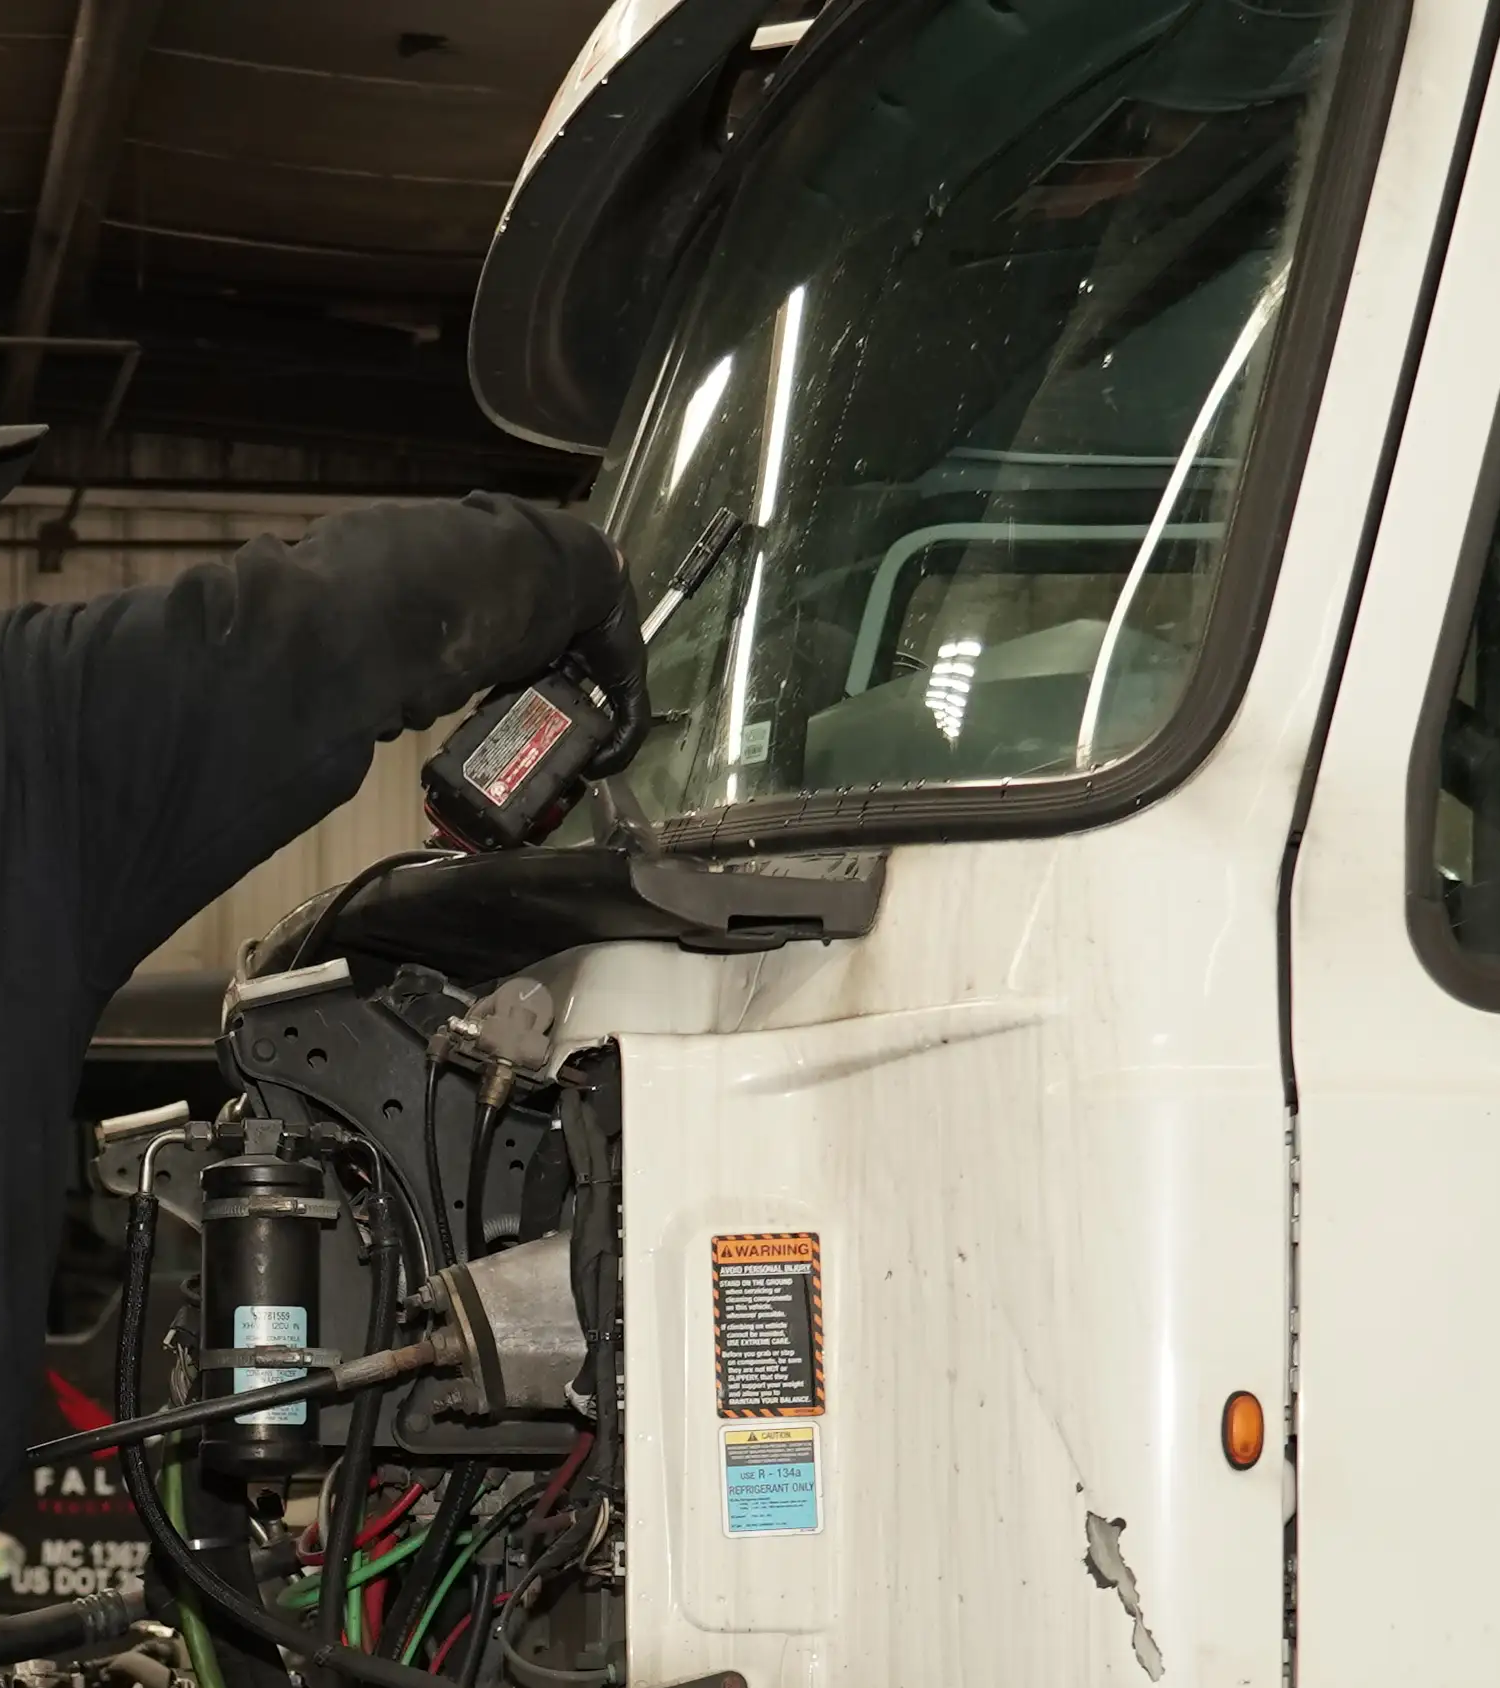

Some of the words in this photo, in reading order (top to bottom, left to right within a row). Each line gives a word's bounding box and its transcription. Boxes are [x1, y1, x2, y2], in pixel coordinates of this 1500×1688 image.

[736, 1244, 809, 1257] WARNING
[720, 1266, 742, 1274] AVOID
[744, 1265, 783, 1274] PERSONAL
[784, 1264, 811, 1273] INJURY
[765, 1278, 793, 1286] GROUND
[757, 1350, 771, 1358] grab
[742, 1382, 766, 1390] support
[782, 1381, 804, 1389] weight
[762, 1431, 791, 1440] CAUTION
[741, 1472, 755, 1480] USE
[759, 1469, 765, 1479] R
[777, 1468, 801, 1477] 134a
[34, 1466, 130, 1496] FAL
[729, 1484, 789, 1495] REFRIGERANT
[792, 1483, 814, 1492] ONLY
[41, 1539, 85, 1567] MC
[11, 1567, 50, 1594] US
[54, 1567, 112, 1596] DOT
